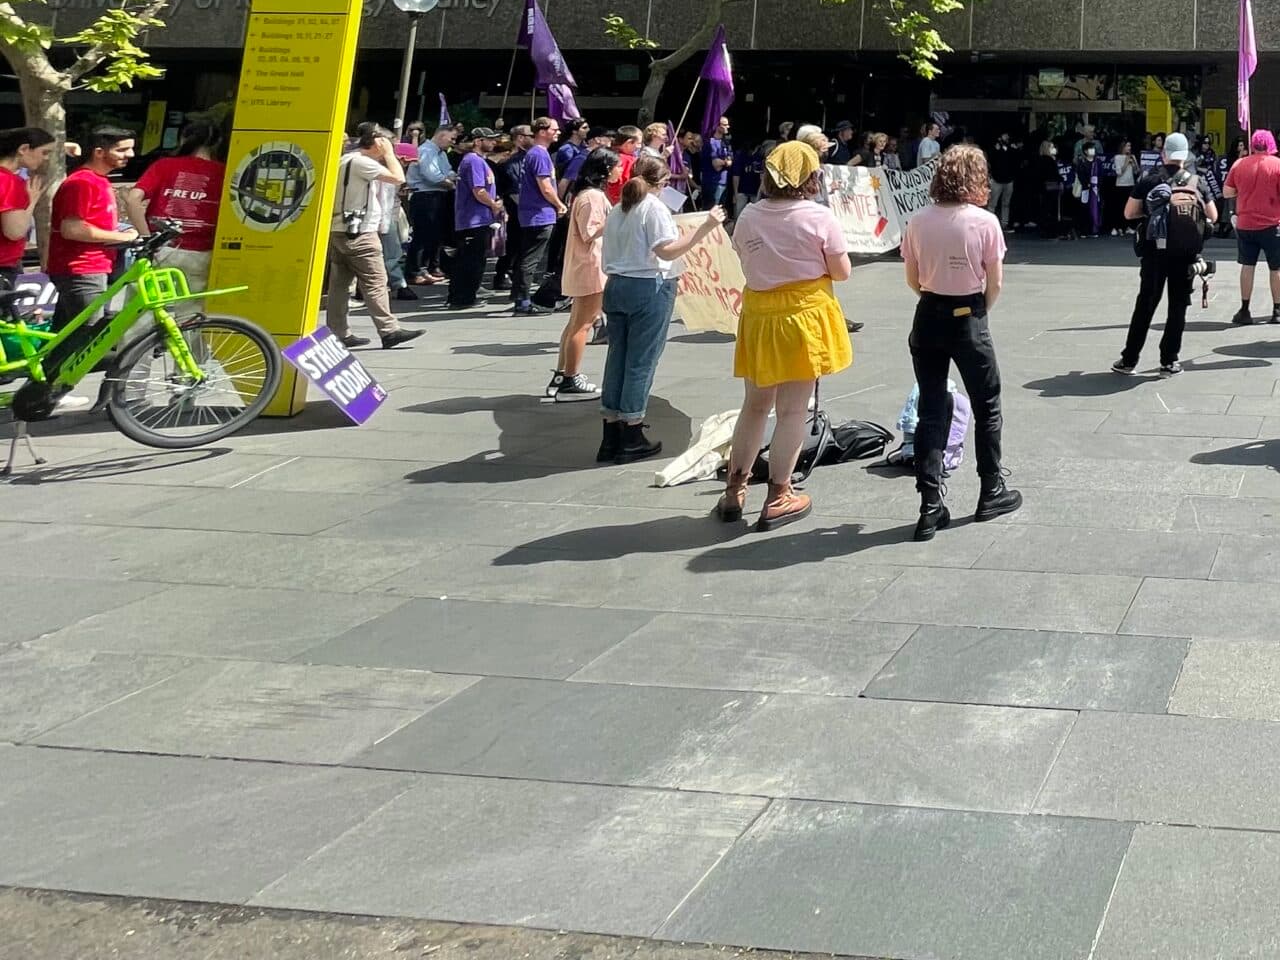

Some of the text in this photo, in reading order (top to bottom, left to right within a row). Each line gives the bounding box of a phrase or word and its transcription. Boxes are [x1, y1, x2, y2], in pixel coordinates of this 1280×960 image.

[164, 188, 207, 200] FRE UP
[298, 334, 350, 380] STRIKE
[324, 360, 372, 405] TODAY
